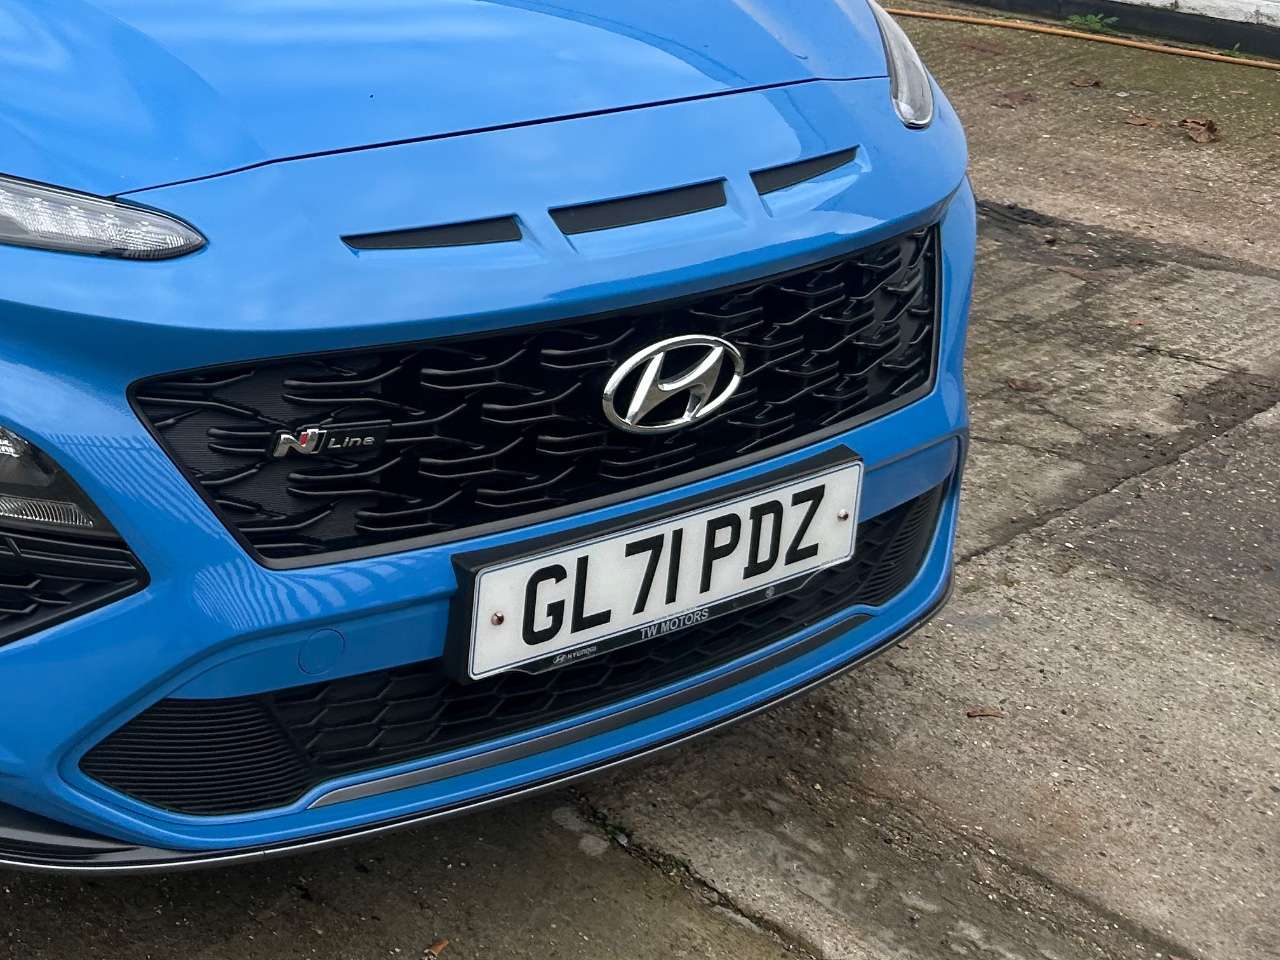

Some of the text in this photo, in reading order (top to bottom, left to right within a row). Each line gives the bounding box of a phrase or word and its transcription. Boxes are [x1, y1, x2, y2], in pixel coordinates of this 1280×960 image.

[700, 484, 826, 594] PDZ
[640, 626, 658, 640] TW
[660, 608, 709, 636] MOTORS
